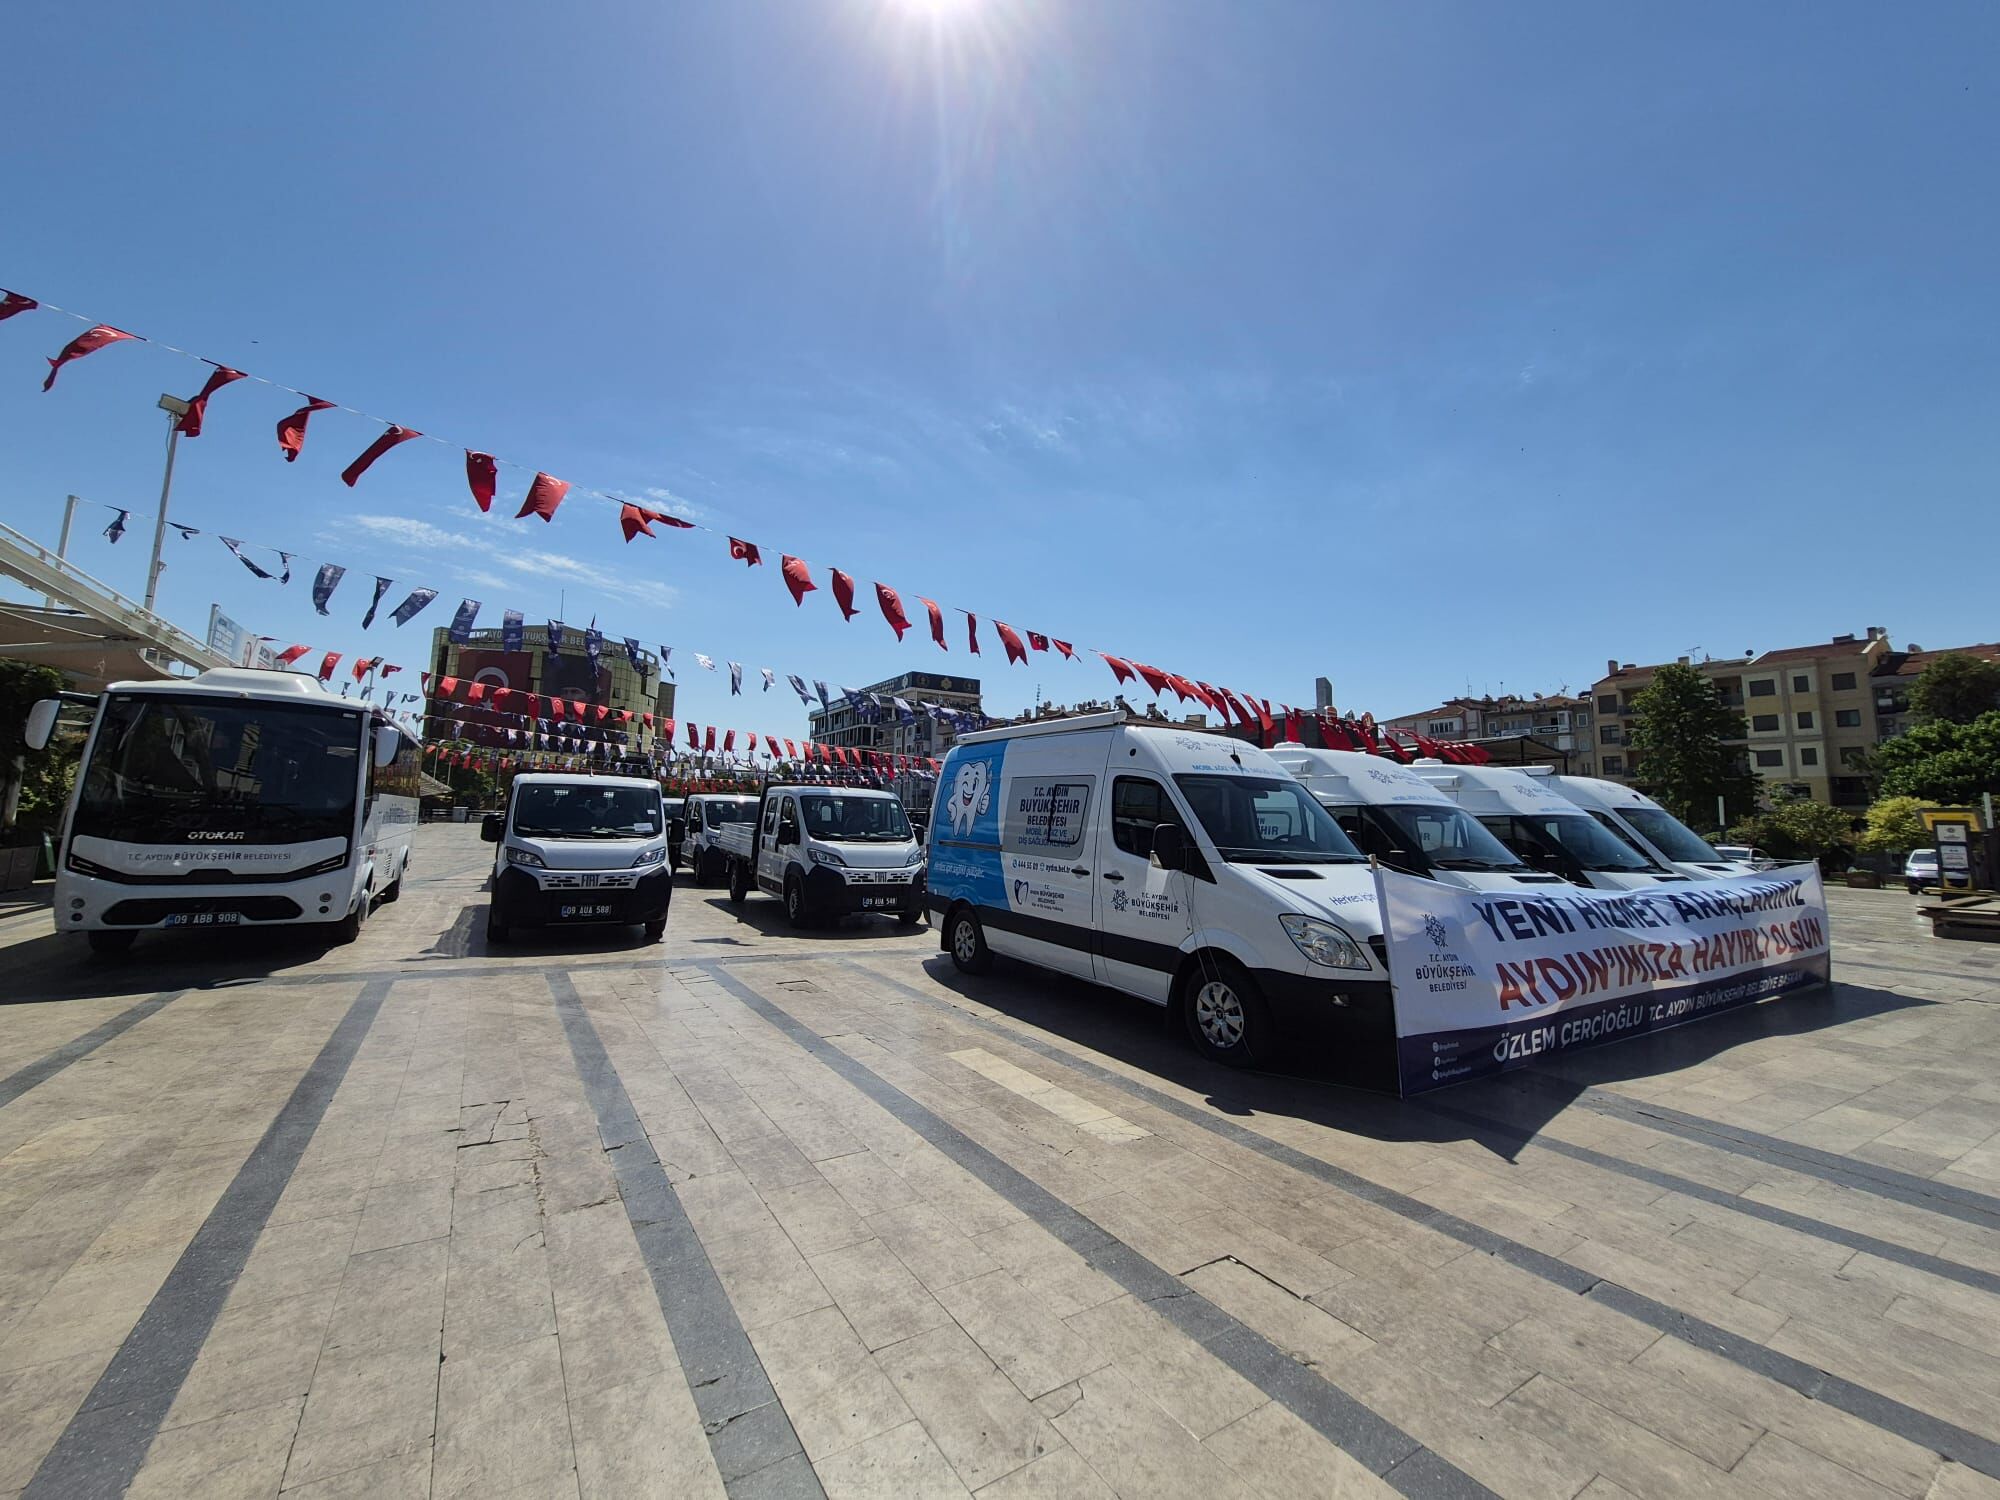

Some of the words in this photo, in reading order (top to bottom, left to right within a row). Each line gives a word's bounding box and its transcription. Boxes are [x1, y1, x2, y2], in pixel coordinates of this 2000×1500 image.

[1033, 786, 1045, 797] T.C.
[187, 831, 246, 840] OTOKAR
[128, 853, 141, 861] T.C.
[145, 853, 173, 861] AYDIN
[174, 850, 242, 862] BÜYÜKŞEHİR
[243, 852, 292, 861] BELEDİYESİ
[1018, 861, 1026, 869] 444
[581, 874, 600, 887] FIAT
[567, 906, 576, 914] 09
[579, 906, 593, 914] AUA
[596, 905, 610, 914] 588
[1131, 898, 1179, 913] BÜYÜKŞEHİR
[1472, 893, 1577, 942] YENİ
[1567, 891, 1671, 930] HİZMET
[1667, 879, 1806, 921] ARAÇLARIMIZ
[174, 914, 188, 924] 09
[217, 912, 237, 923] 908
[1139, 910, 1170, 920] BELEDİYESİ
[1692, 927, 1769, 974] HAYIRLI
[1771, 917, 1824, 956] OLSUN
[1429, 953, 1442, 962] T.C.
[1443, 953, 1459, 962] AYDIN
[1415, 963, 1477, 981] BÜYÜKŞEHİR
[1429, 980, 1468, 993] BELEDİYESİ
[1493, 1026, 1556, 1062] ÖZLEM
[1561, 1004, 1644, 1048] ÇERÇİOĞLU
[1649, 1004, 1665, 1021] T.C.
[1666, 998, 1694, 1018] AYDIN
[1695, 982, 1745, 1009] BÜYÜKŞEHİR
